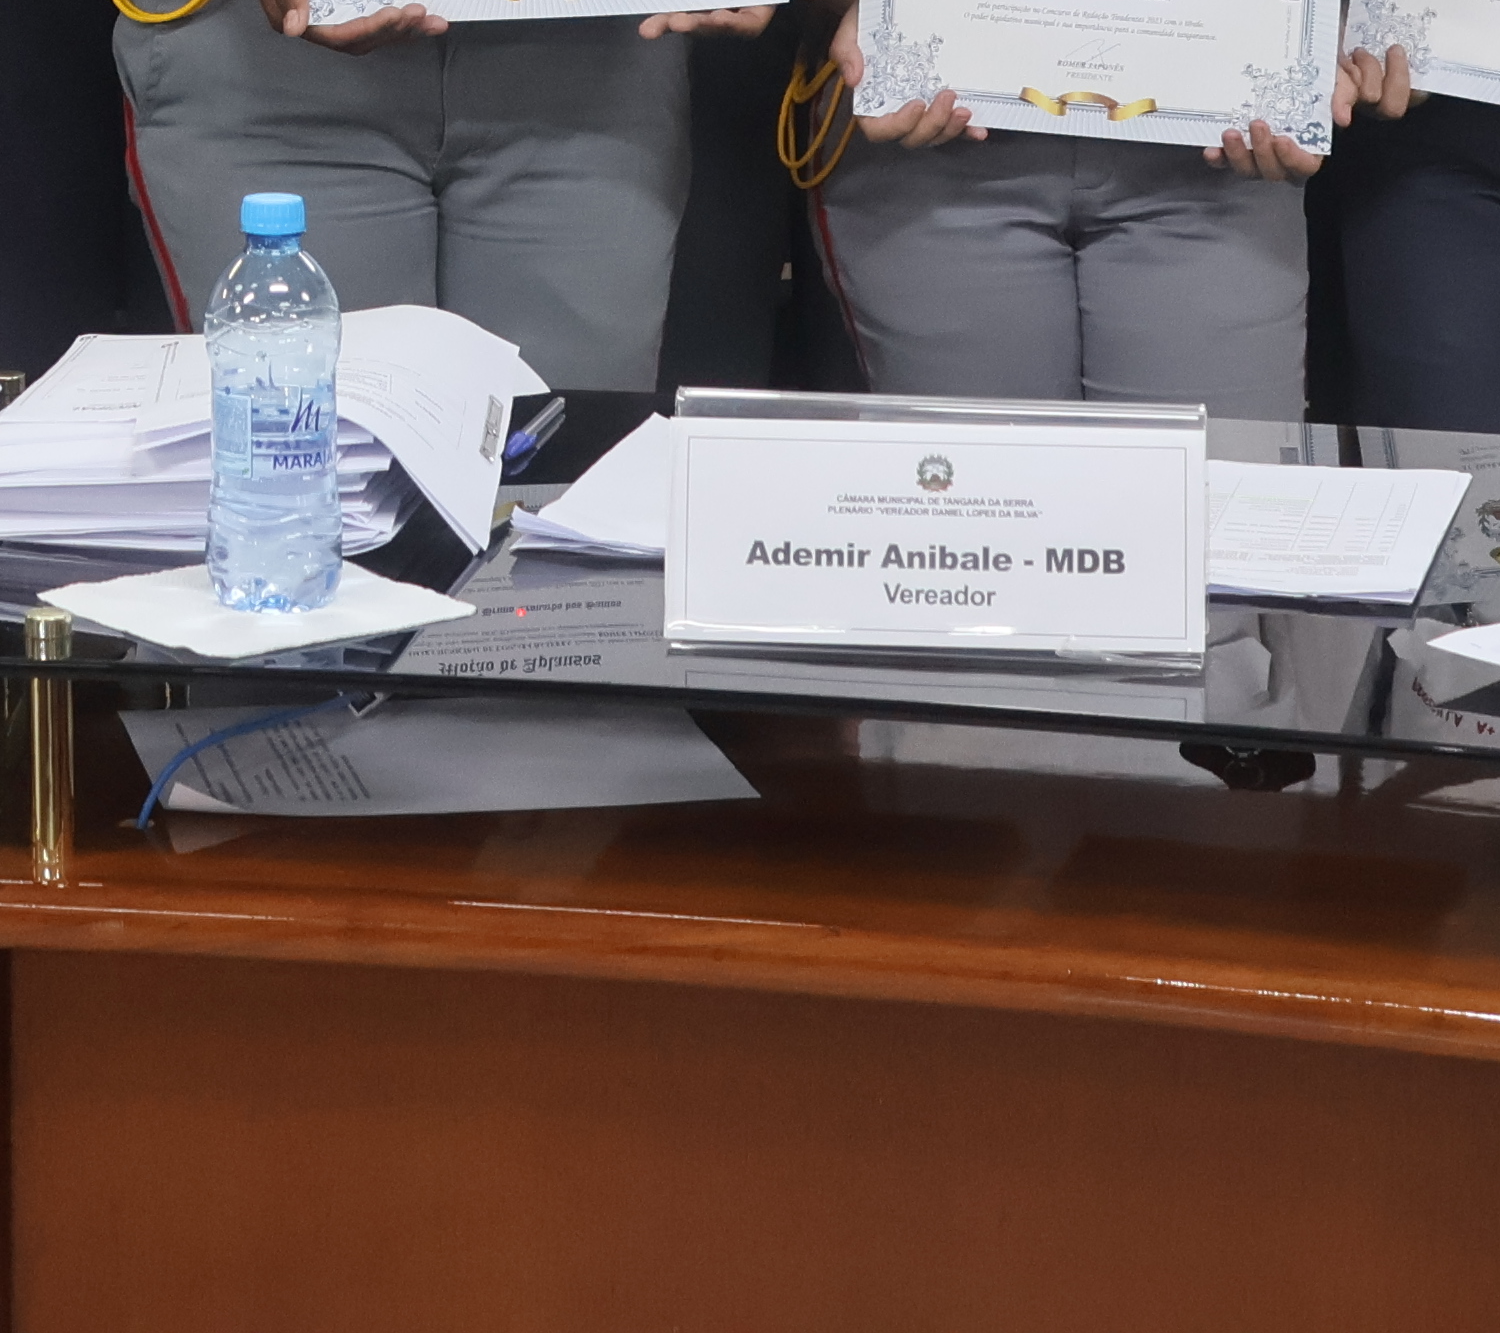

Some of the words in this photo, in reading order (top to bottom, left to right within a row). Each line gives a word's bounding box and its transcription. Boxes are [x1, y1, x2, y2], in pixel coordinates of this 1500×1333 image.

[745, 540, 872, 569] Ademir
[880, 543, 1013, 573] Anibale
[1045, 548, 1126, 575] MDB
[883, 582, 997, 608] Vereador
